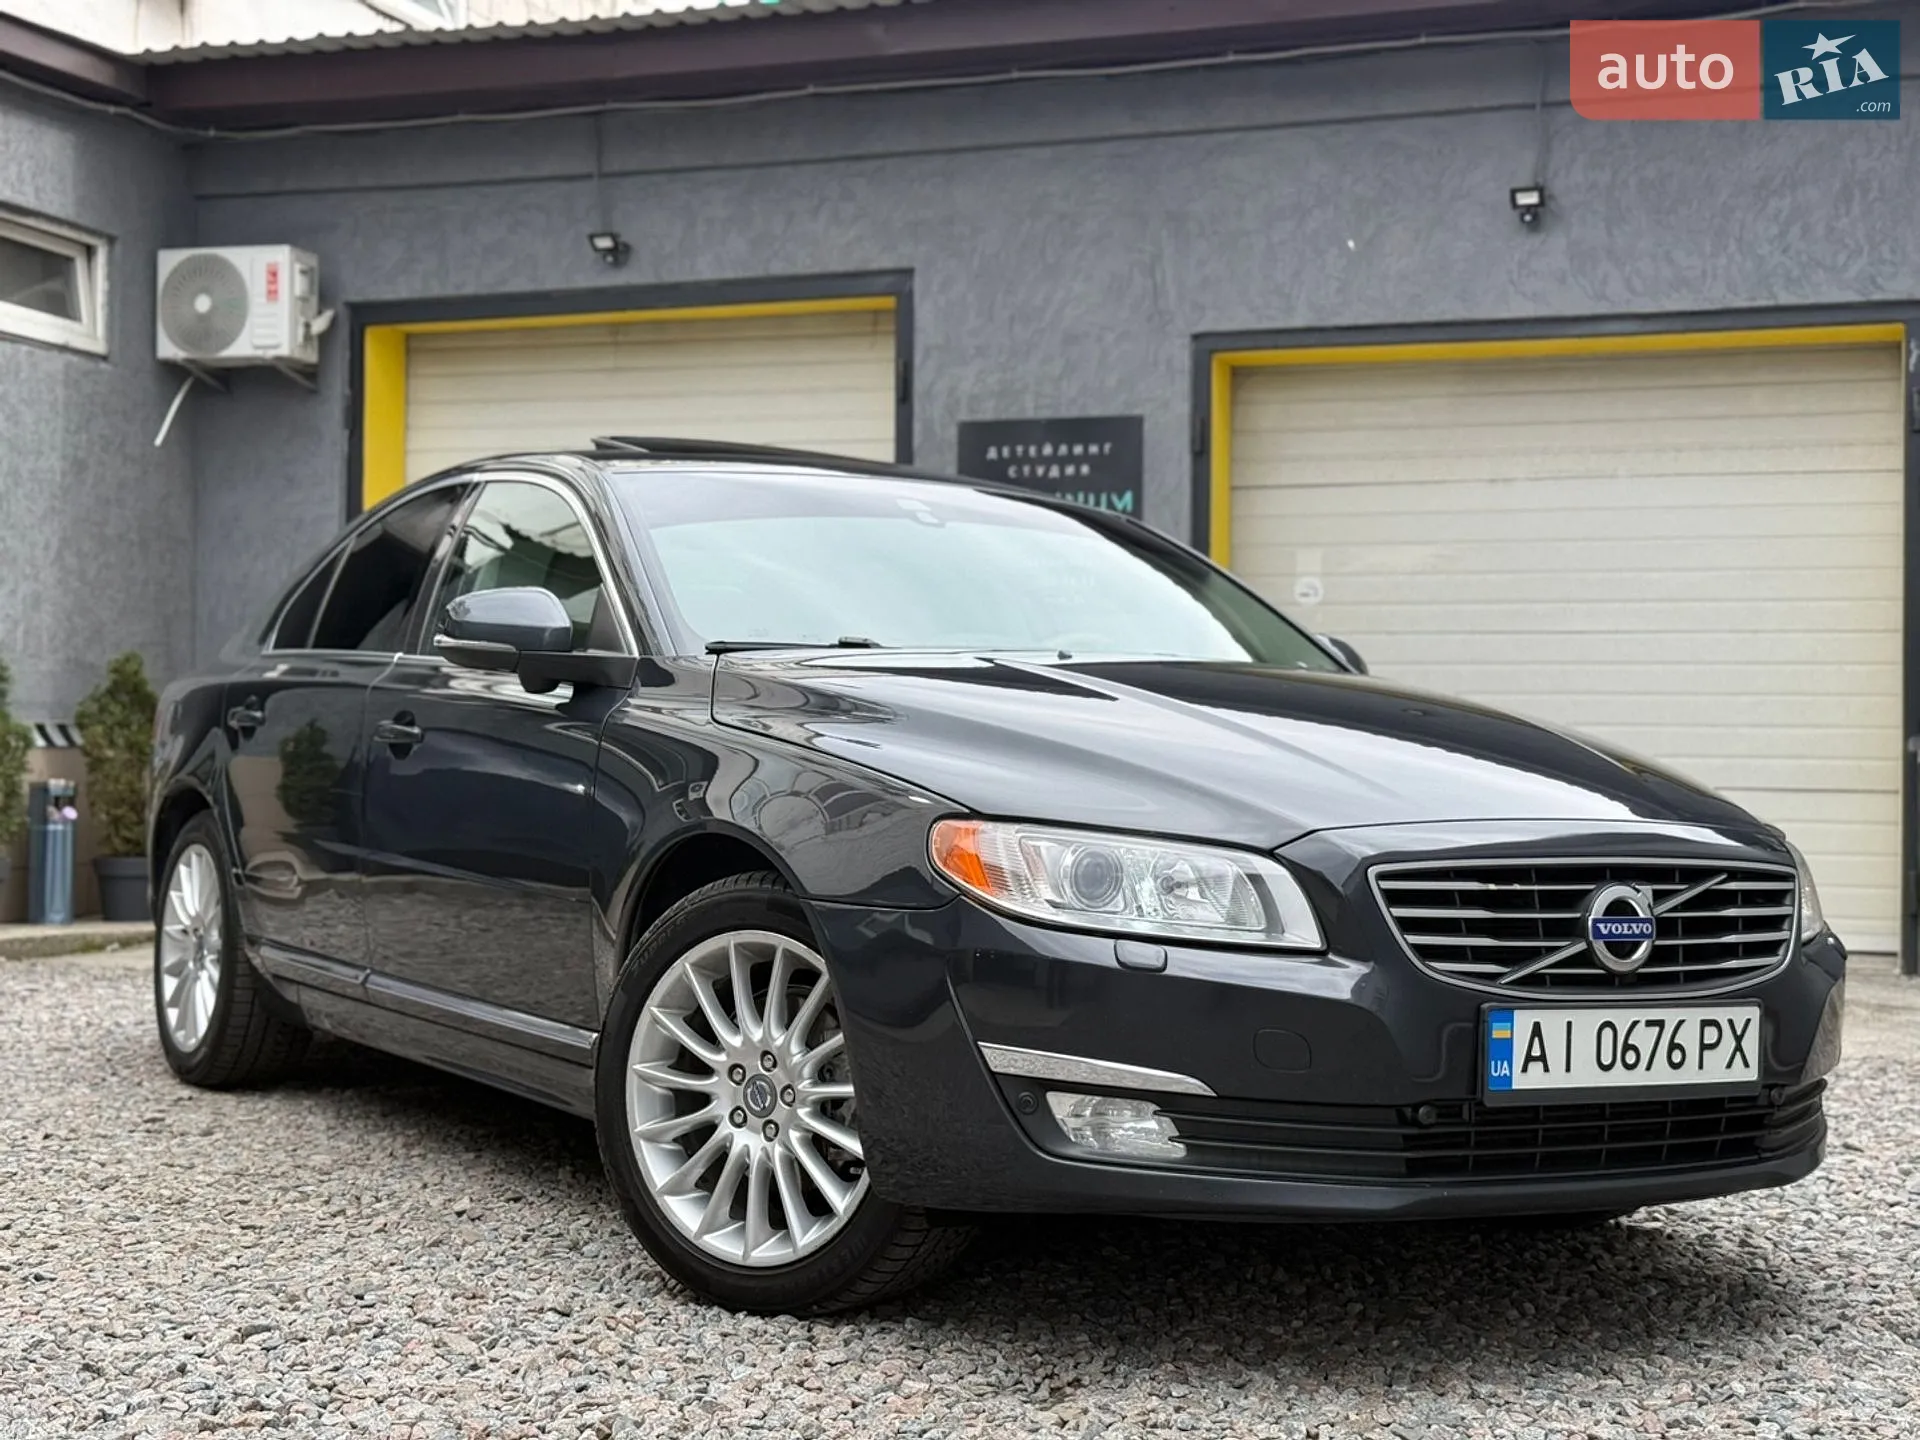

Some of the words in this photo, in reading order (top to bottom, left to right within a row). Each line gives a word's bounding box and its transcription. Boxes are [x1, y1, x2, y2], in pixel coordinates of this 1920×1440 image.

[985, 441, 1113, 461] ДЕТЕЙЛИНГ
[1007, 463, 1091, 479] СТУДИЯ
[1596, 922, 1653, 935] VOLVO
[1520, 1020, 1573, 1074] AI
[1595, 1019, 1688, 1072] 0676
[1697, 1018, 1752, 1070] PX
[1490, 1060, 1511, 1077] UA
